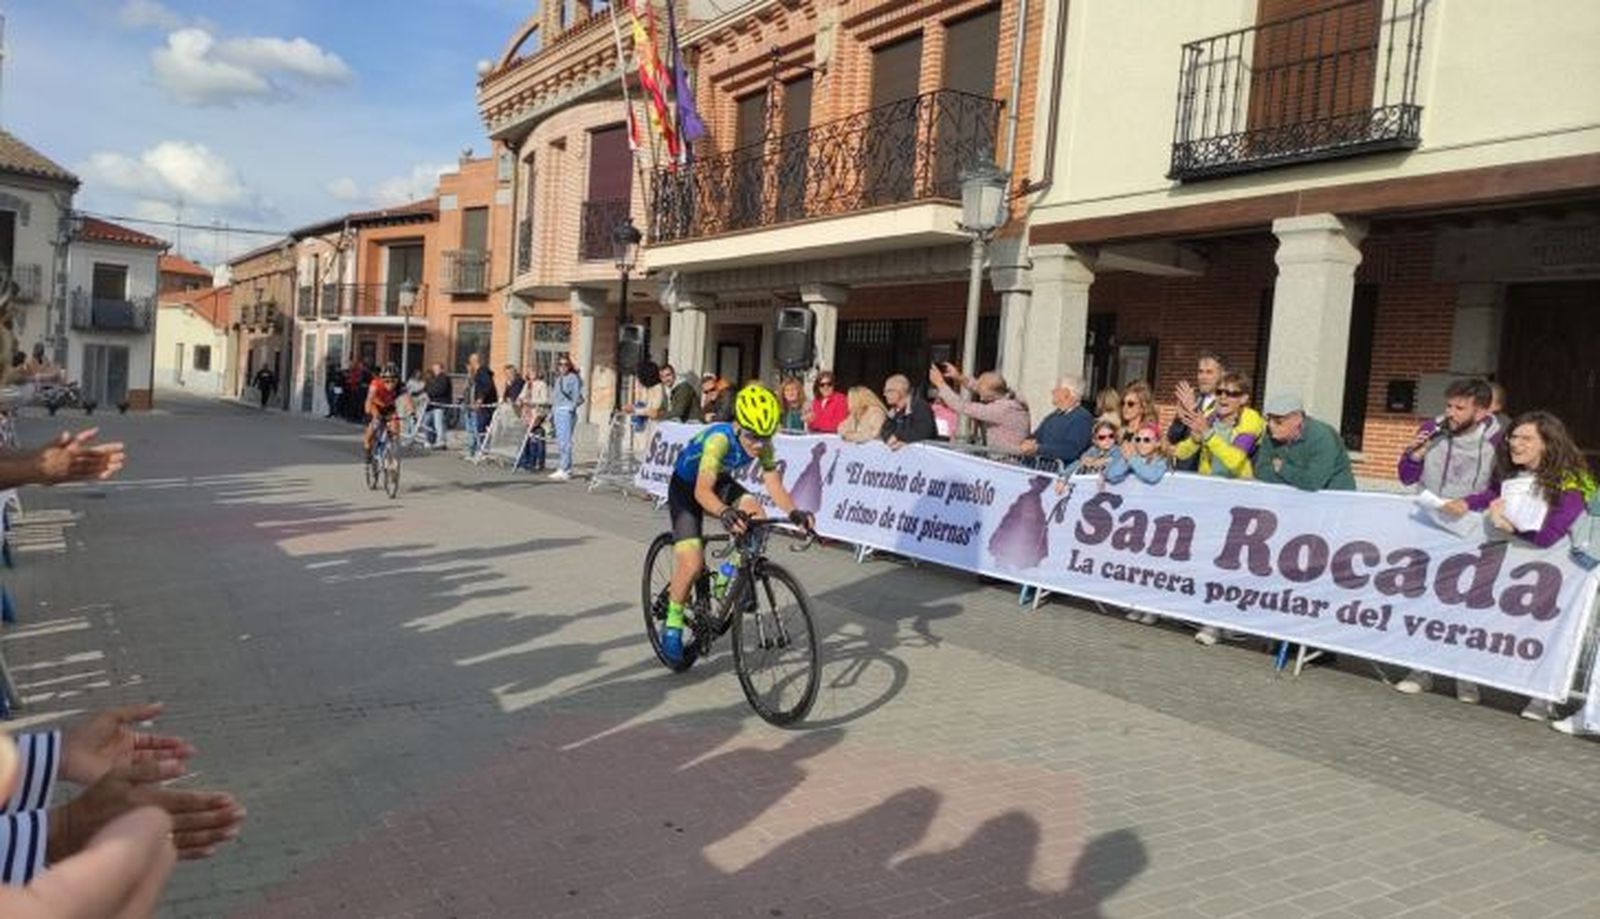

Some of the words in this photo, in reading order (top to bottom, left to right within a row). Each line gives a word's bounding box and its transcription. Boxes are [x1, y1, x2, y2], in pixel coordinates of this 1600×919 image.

[833, 499, 847, 520] al
[845, 501, 878, 527] ritmo
[878, 507, 895, 529] de
[897, 510, 919, 535] tus
[862, 466, 909, 493] corazón
[909, 471, 924, 494] de
[927, 478, 945, 498] un
[945, 479, 996, 506] pueblo
[1074, 492, 1196, 561] San
[1213, 506, 1564, 621] Rocada
[1067, 550, 1093, 574] La
[1101, 561, 1196, 595] carrera
[1204, 582, 1330, 618] popular
[1336, 600, 1392, 631] del
[1404, 613, 1544, 660] verano
